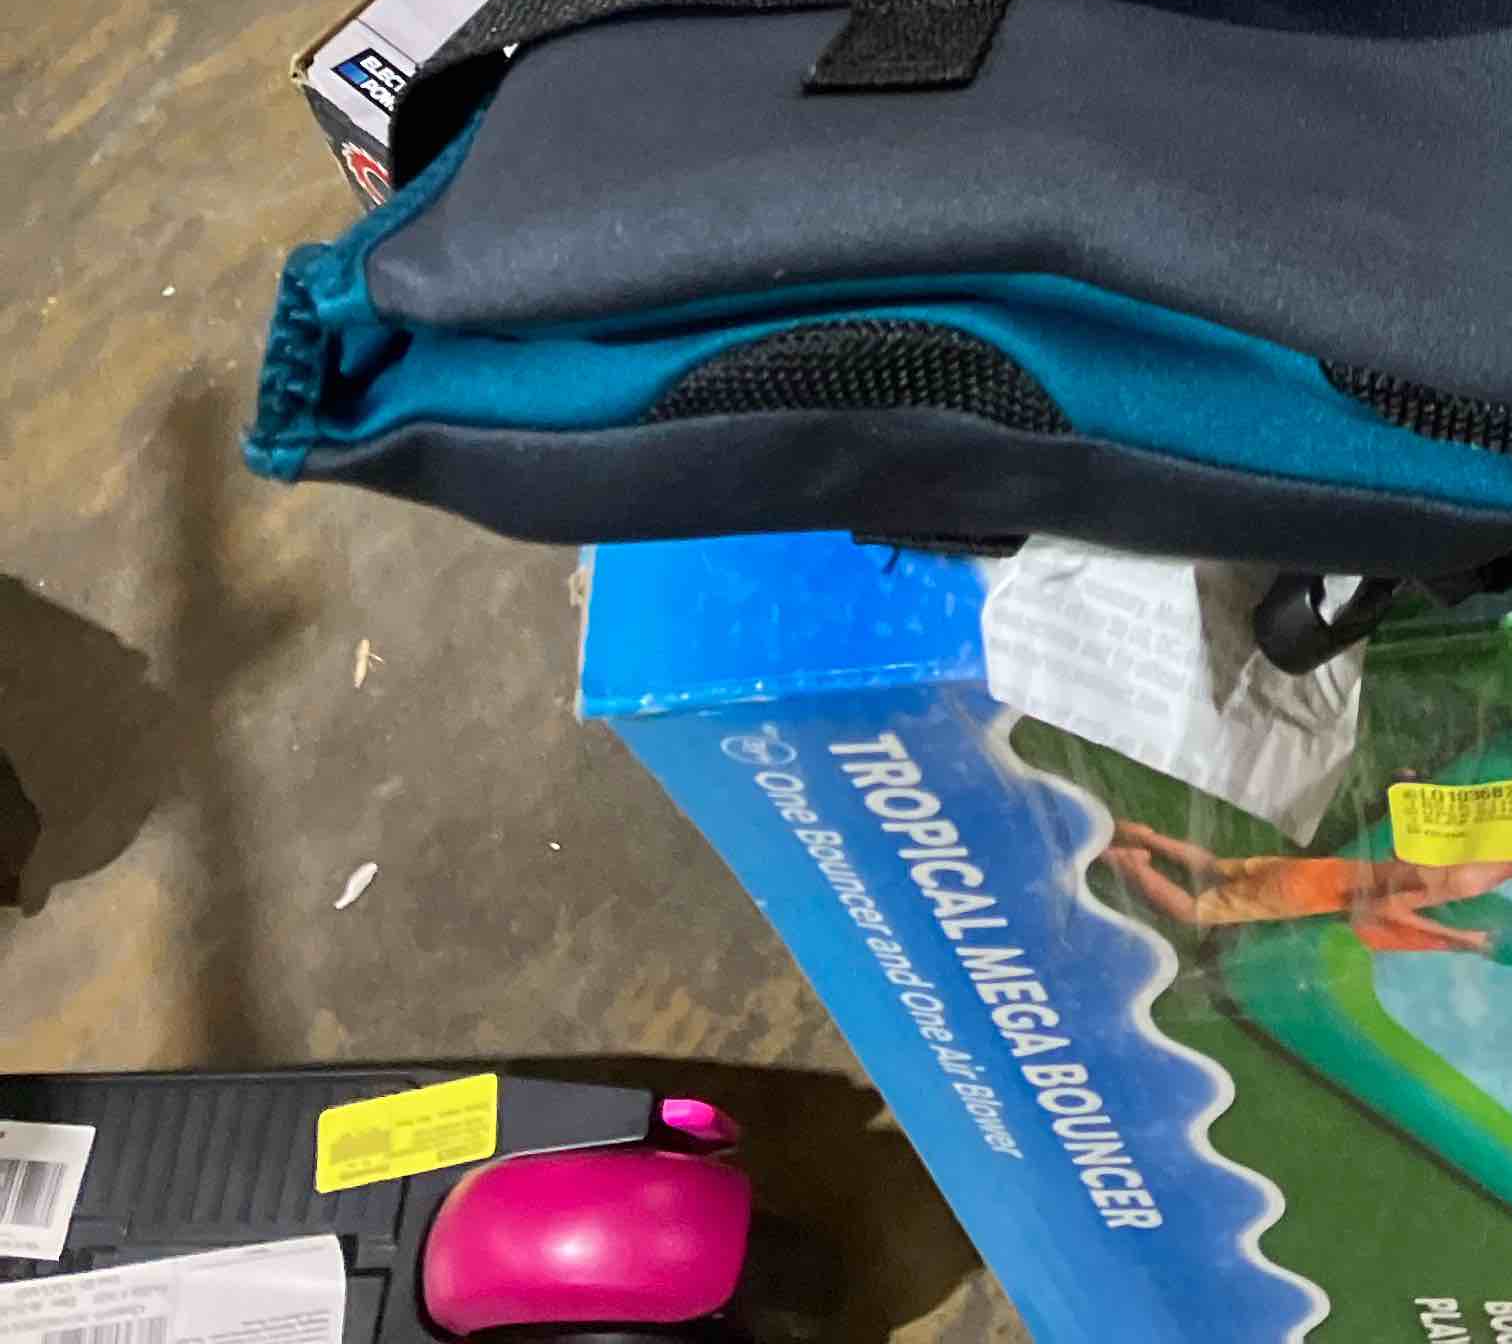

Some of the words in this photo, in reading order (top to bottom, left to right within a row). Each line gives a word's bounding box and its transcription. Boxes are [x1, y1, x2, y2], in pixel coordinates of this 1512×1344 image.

[753, 770, 818, 824] One
[794, 828, 893, 937] Bouncer
[828, 729, 1008, 941] TROPICAL
[954, 946, 1072, 1058] MEGA
[1020, 1063, 1164, 1229] BOUNCER
[865, 936, 935, 989] and
[900, 991, 954, 1043] One
[928, 1043, 986, 1081] Air
[951, 1082, 1024, 1160] Blower
